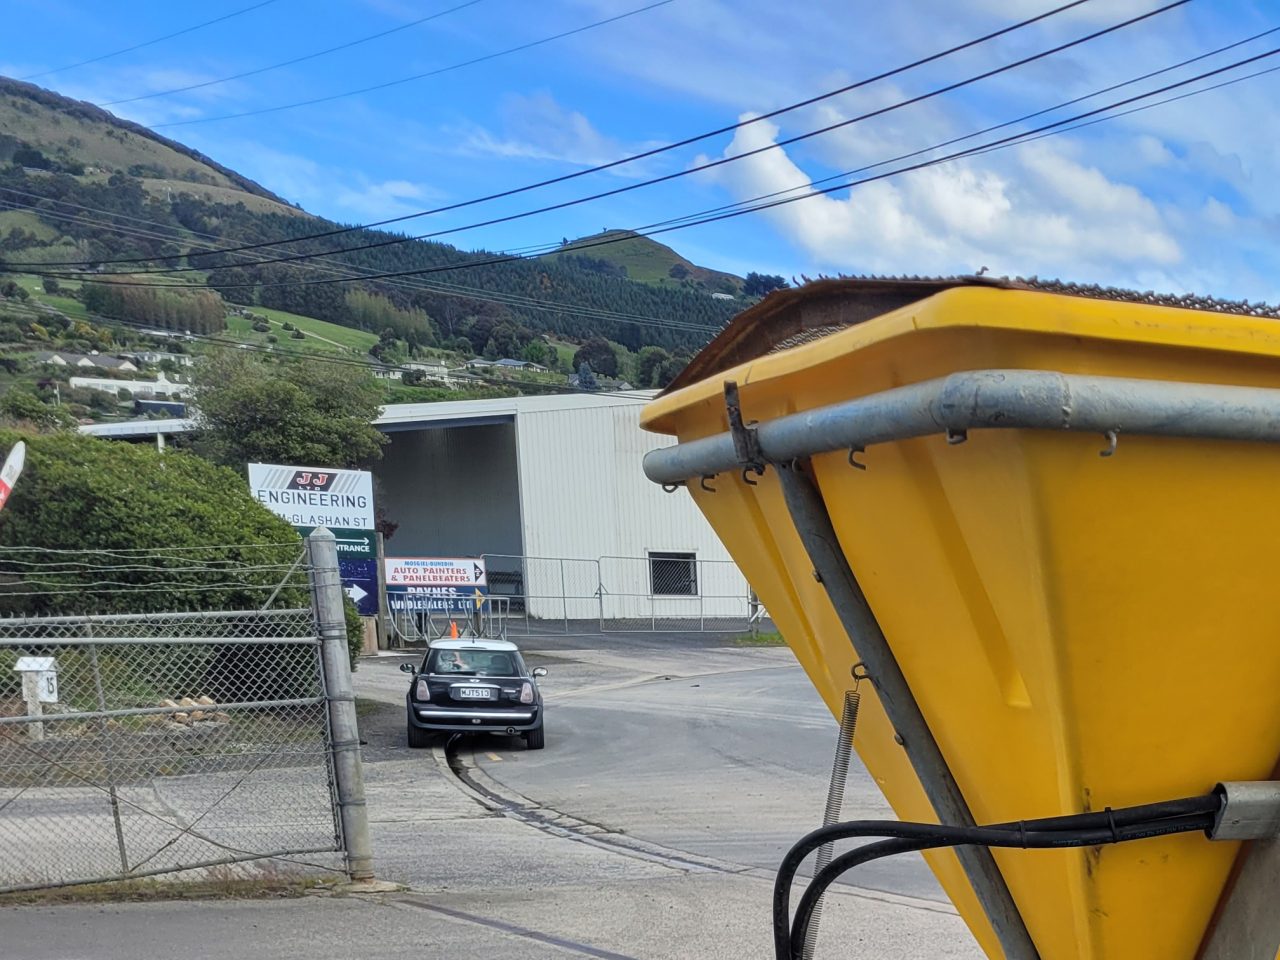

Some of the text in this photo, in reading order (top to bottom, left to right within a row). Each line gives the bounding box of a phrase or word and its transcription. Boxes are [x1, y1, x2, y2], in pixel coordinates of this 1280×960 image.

[257, 489, 367, 509] ENGINEERING
[353, 517, 368, 527] ST
[336, 544, 370, 553] NTRANCE
[423, 567, 467, 575] PAINTERS
